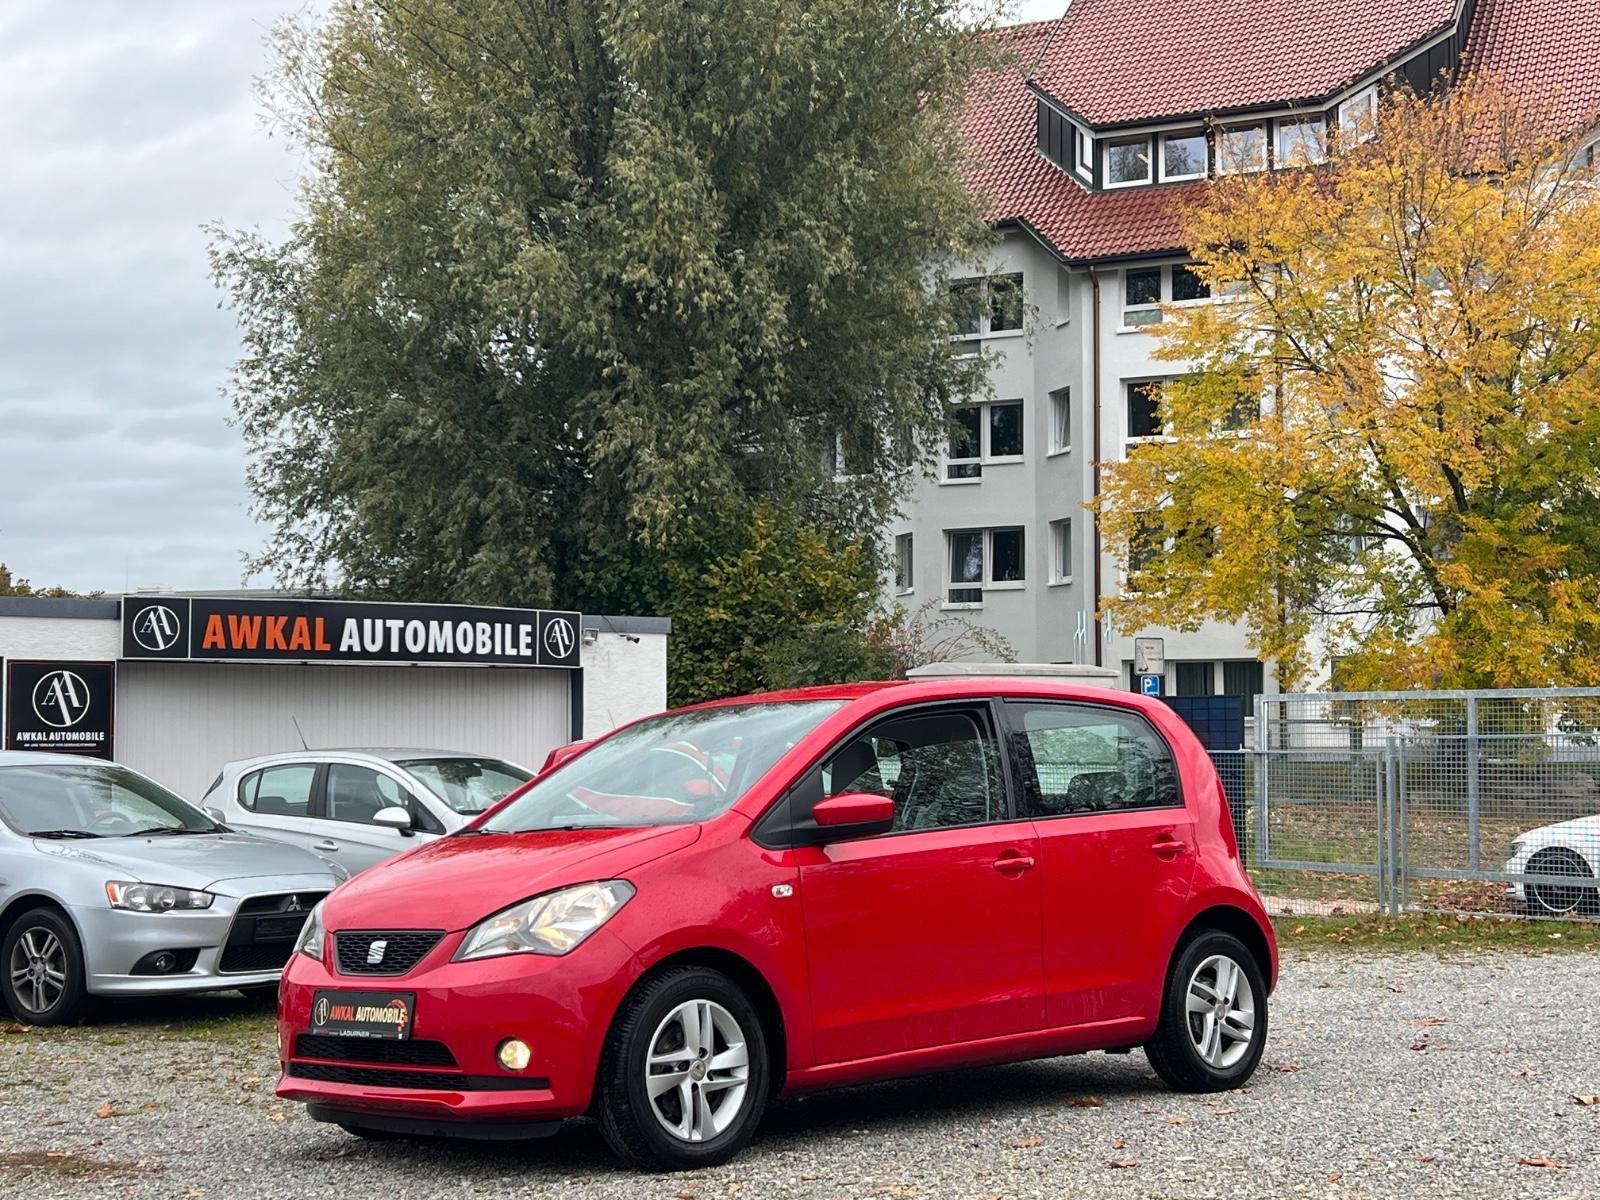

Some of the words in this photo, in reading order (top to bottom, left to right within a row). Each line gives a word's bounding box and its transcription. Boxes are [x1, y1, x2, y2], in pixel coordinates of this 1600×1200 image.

[202, 614, 332, 651] AWKAL
[339, 617, 532, 656] AUTOMOBILE
[17, 732, 47, 741] AWKAL
[49, 732, 104, 741] AUTOMOBILE
[330, 1006, 354, 1021] AWKAL
[355, 1007, 404, 1023] AUTOMOBILE
